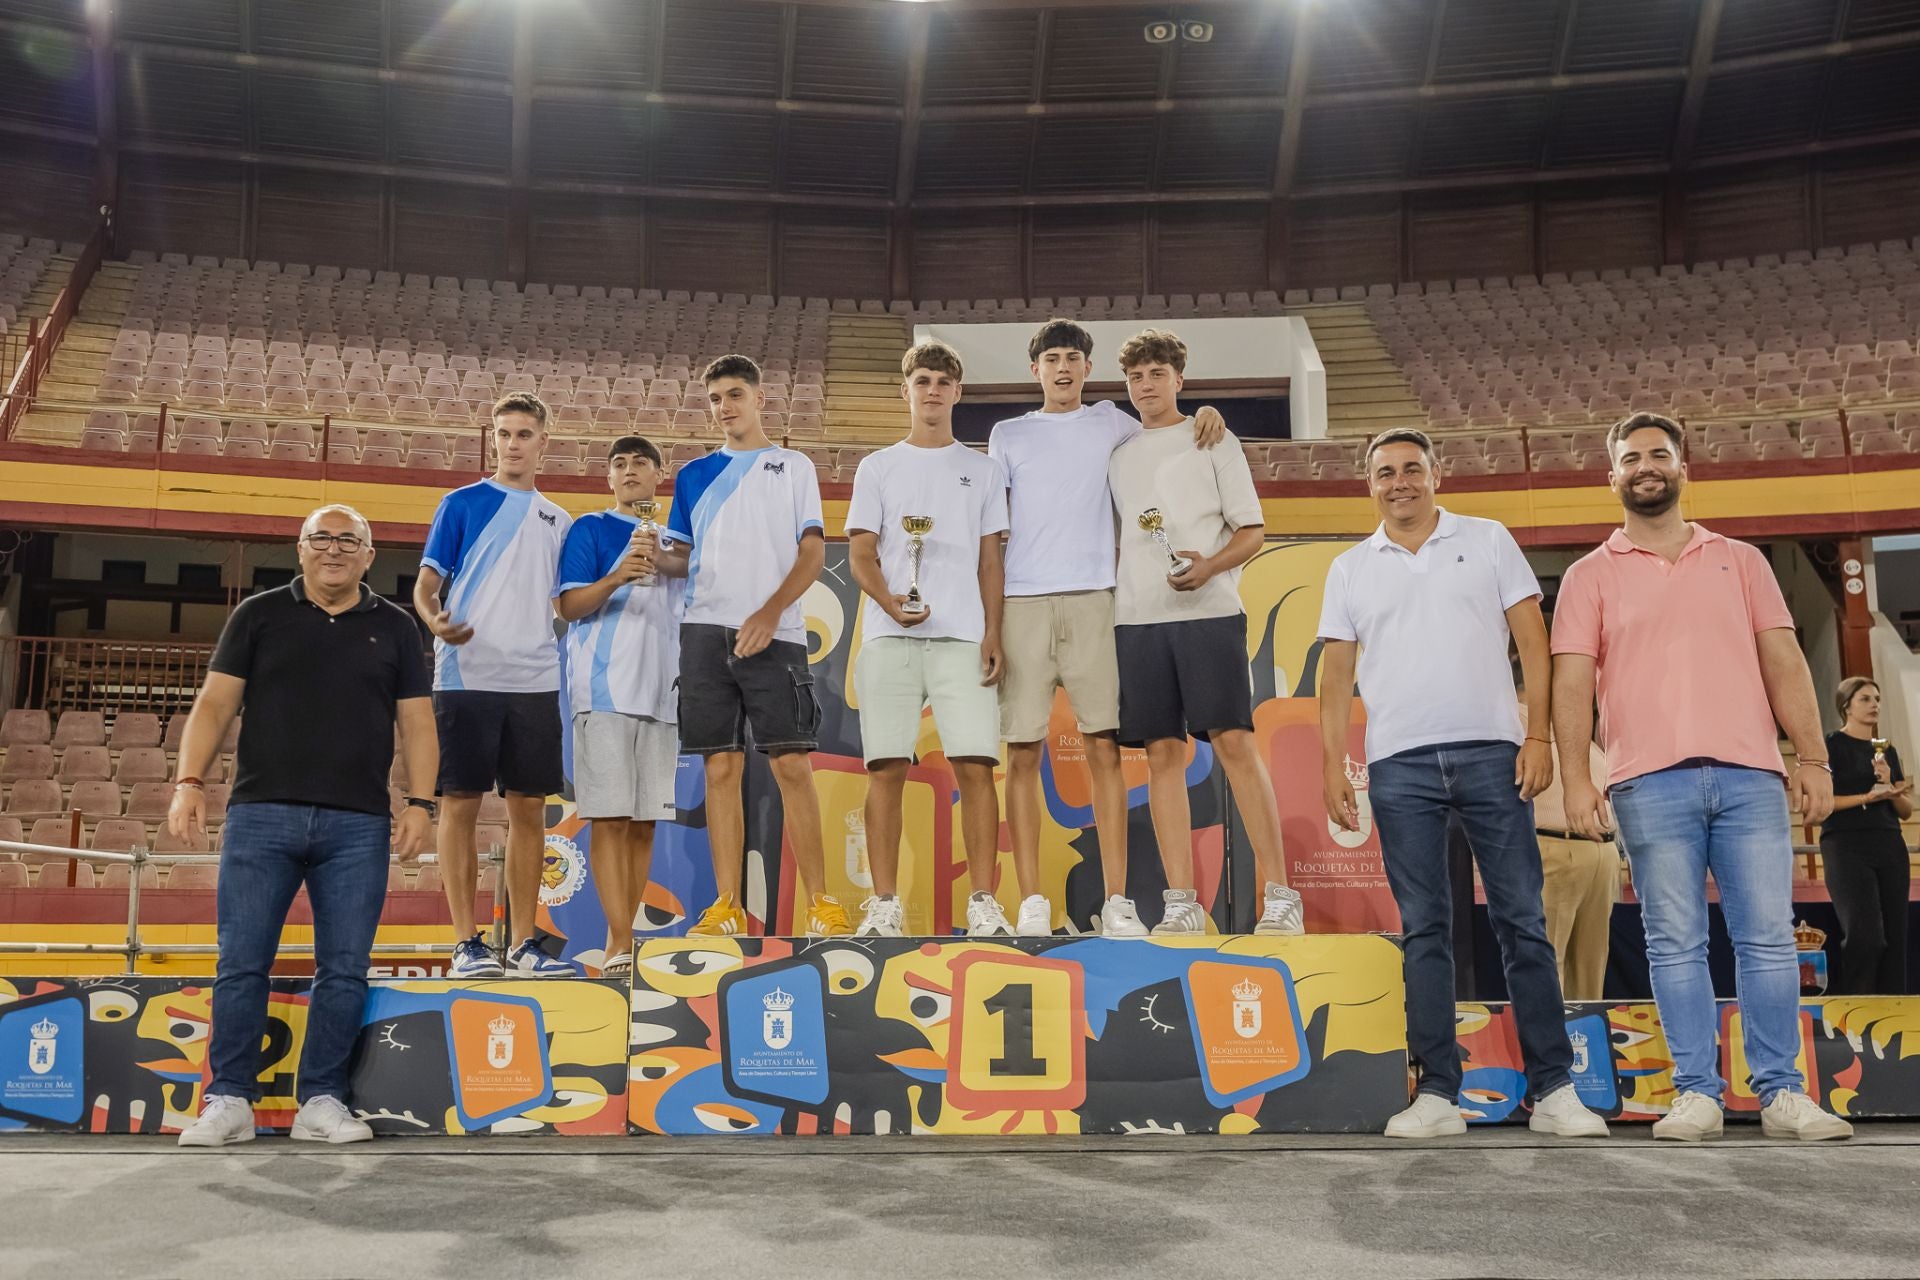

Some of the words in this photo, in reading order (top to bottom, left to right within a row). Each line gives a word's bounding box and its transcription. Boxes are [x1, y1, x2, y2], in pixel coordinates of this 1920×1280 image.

[1313, 850, 1378, 858] AYUNTAMIENTO
[1294, 861, 1356, 874] ROQUETAS
[1360, 863, 1375, 872] DE
[983, 984, 1046, 1076] 1
[1212, 1046, 1251, 1055] ROQUETAS
[1266, 1046, 1284, 1054] MAR
[258, 1016, 294, 1097] 2
[740, 1058, 780, 1067] ROQUETAS
[796, 1058, 815, 1066] MAR
[7, 1080, 43, 1090] ROQUETAS
